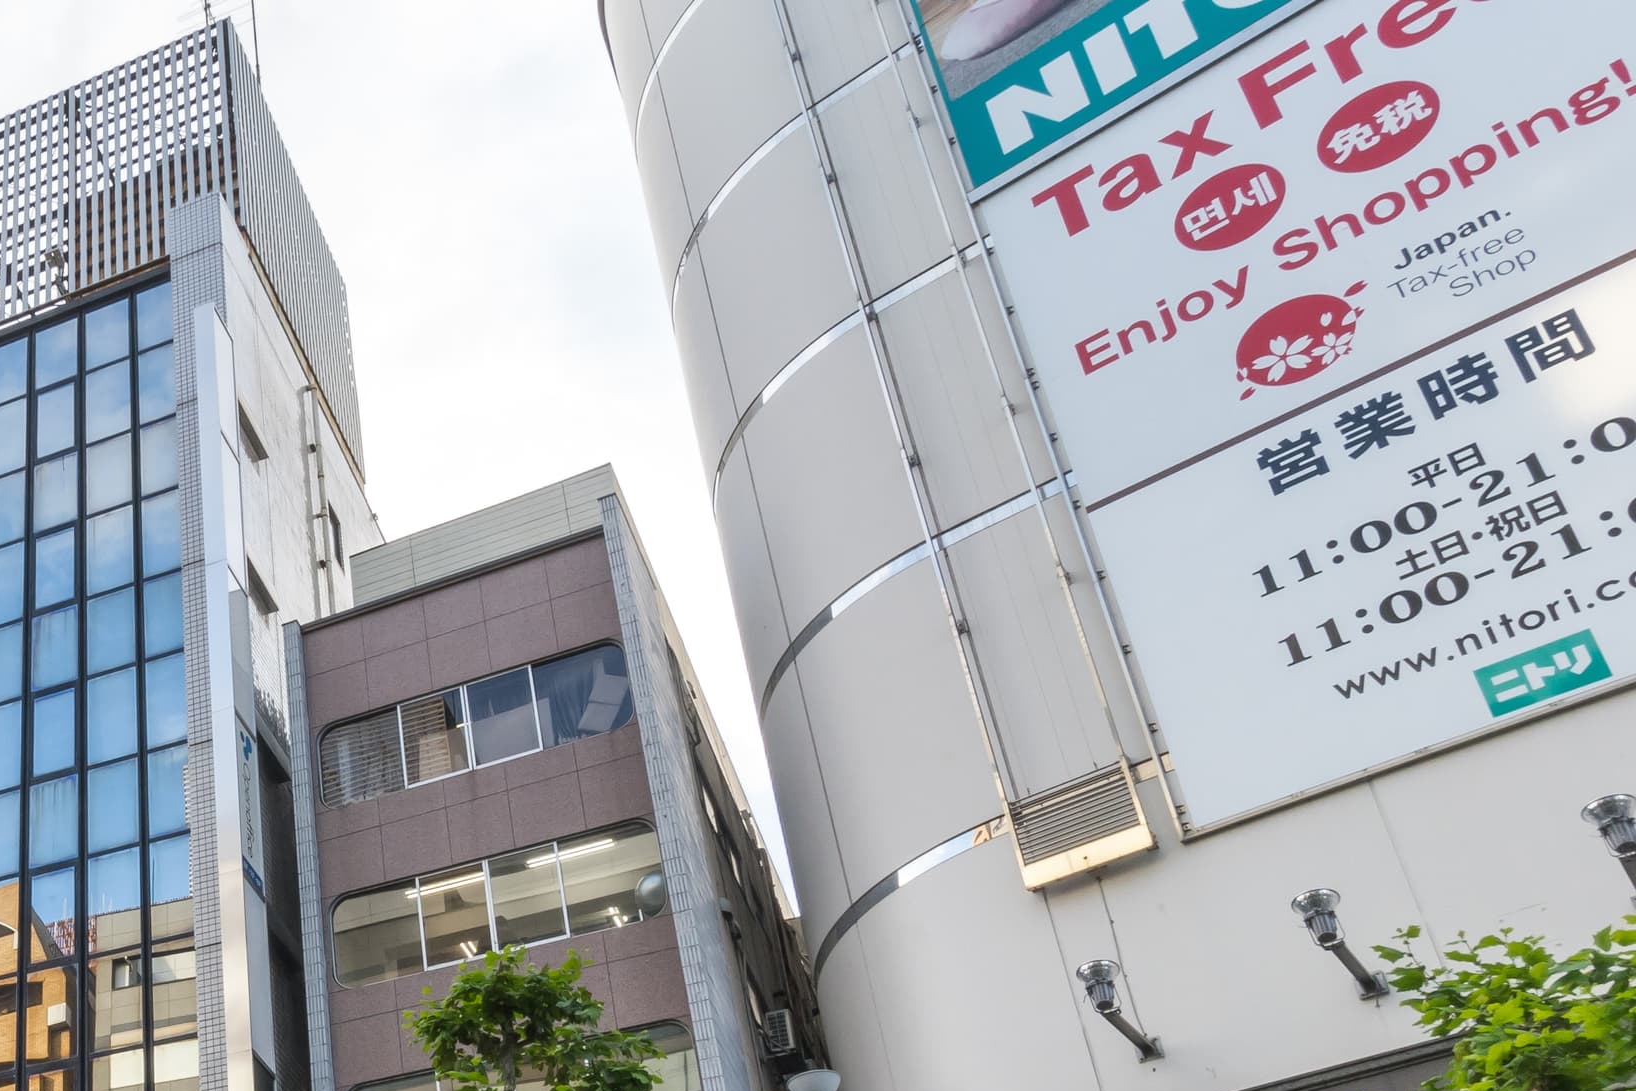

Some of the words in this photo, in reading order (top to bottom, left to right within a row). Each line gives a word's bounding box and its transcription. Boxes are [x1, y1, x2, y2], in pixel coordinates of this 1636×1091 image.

[985, 0, 1263, 155] NIT
[1032, 110, 1232, 236] Tax
[1237, 0, 1494, 129] Fre
[1327, 90, 1433, 164] 免税
[1074, 264, 1250, 375] Enjoy
[1277, 59, 1636, 271] Shopping!
[1180, 171, 1277, 242] 면세
[1394, 207, 1512, 271] Japan.
[1386, 223, 1526, 300] Tax-free
[1449, 246, 1537, 299] Shop
[1256, 308, 1596, 496] 営業時間
[1407, 442, 1486, 489] 平日
[1277, 497, 1636, 668] 11:00-21:
[1332, 569, 1636, 700] www.nitori.c
[1490, 645, 1592, 704] ニトリ
